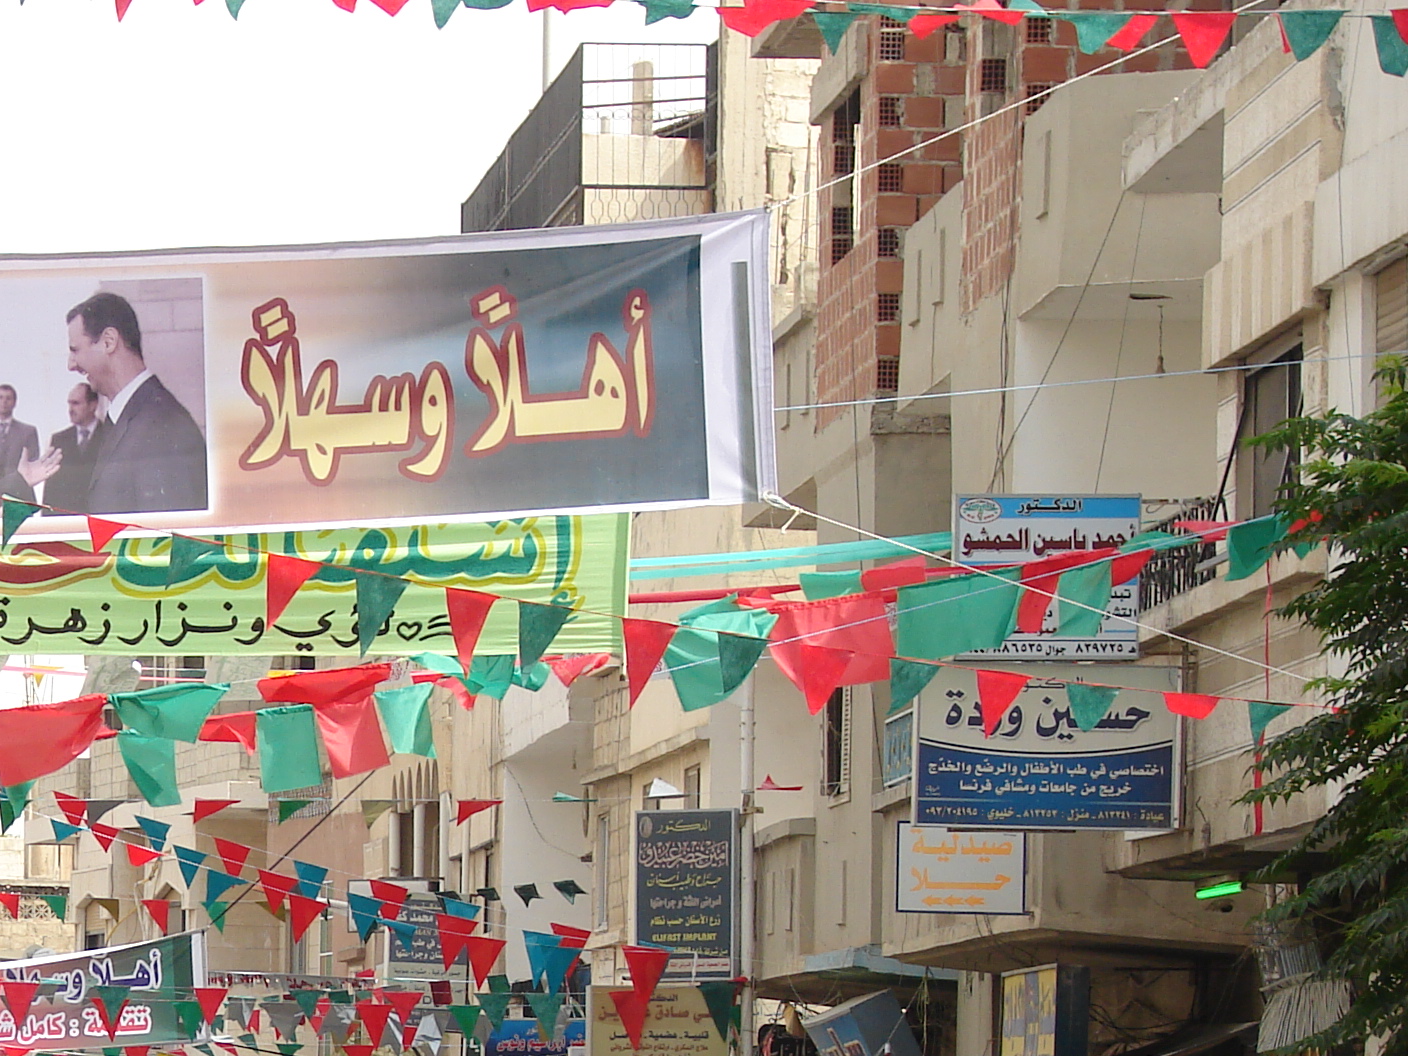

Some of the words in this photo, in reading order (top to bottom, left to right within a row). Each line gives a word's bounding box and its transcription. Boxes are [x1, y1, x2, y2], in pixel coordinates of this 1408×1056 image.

[1017, 498, 1083, 516] الدكتور
[1066, 763, 1088, 778] طب
[1089, 762, 1107, 780] في
[1108, 764, 1164, 780] اختصاصي
[959, 778, 993, 794] فرنسا
[1038, 779, 1077, 797] جامعات
[1080, 782, 1097, 797] من
[1098, 782, 1133, 798] خريج
[910, 828, 1014, 863] صيدلية
[909, 867, 1012, 892] حلا
